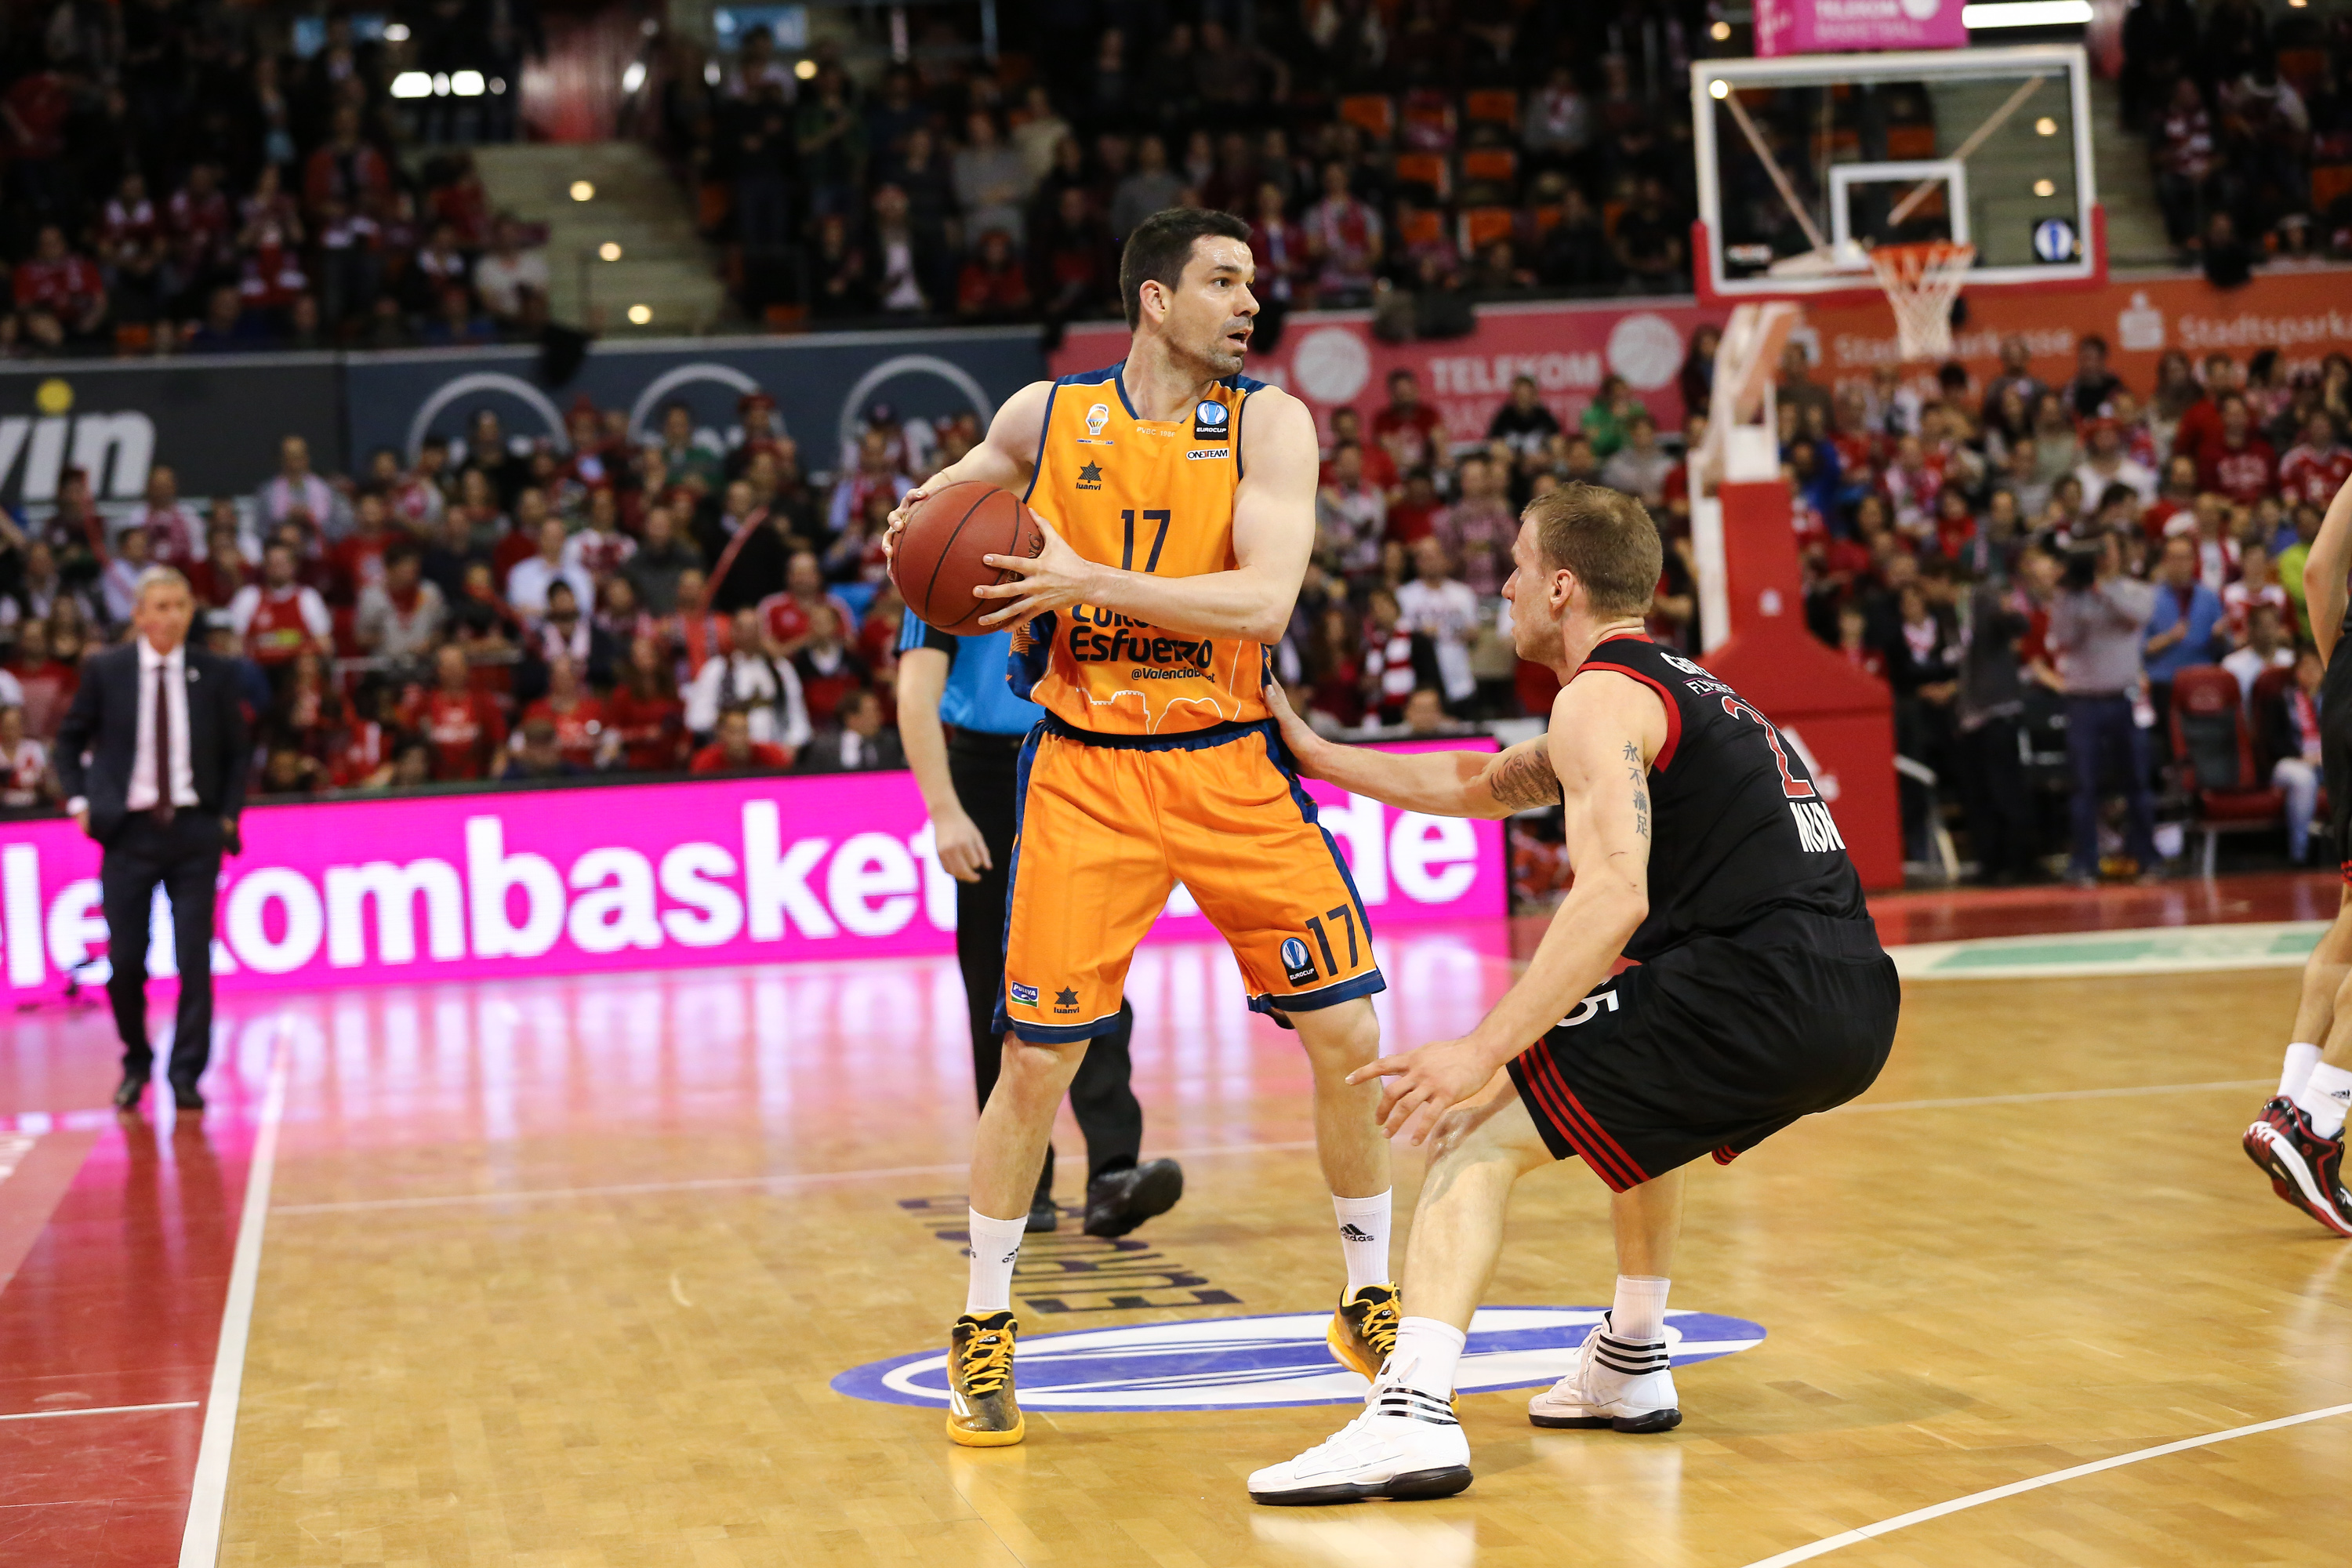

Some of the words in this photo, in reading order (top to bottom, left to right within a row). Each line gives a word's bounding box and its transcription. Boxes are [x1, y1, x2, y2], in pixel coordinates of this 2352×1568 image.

[1076, 482, 1102, 491] luanvi
[1121, 509, 1171, 572] 17
[1305, 903, 1359, 977] 17
[1289, 968, 1315, 981] EUROCUP
[1013, 984, 1036, 996] PULEVA
